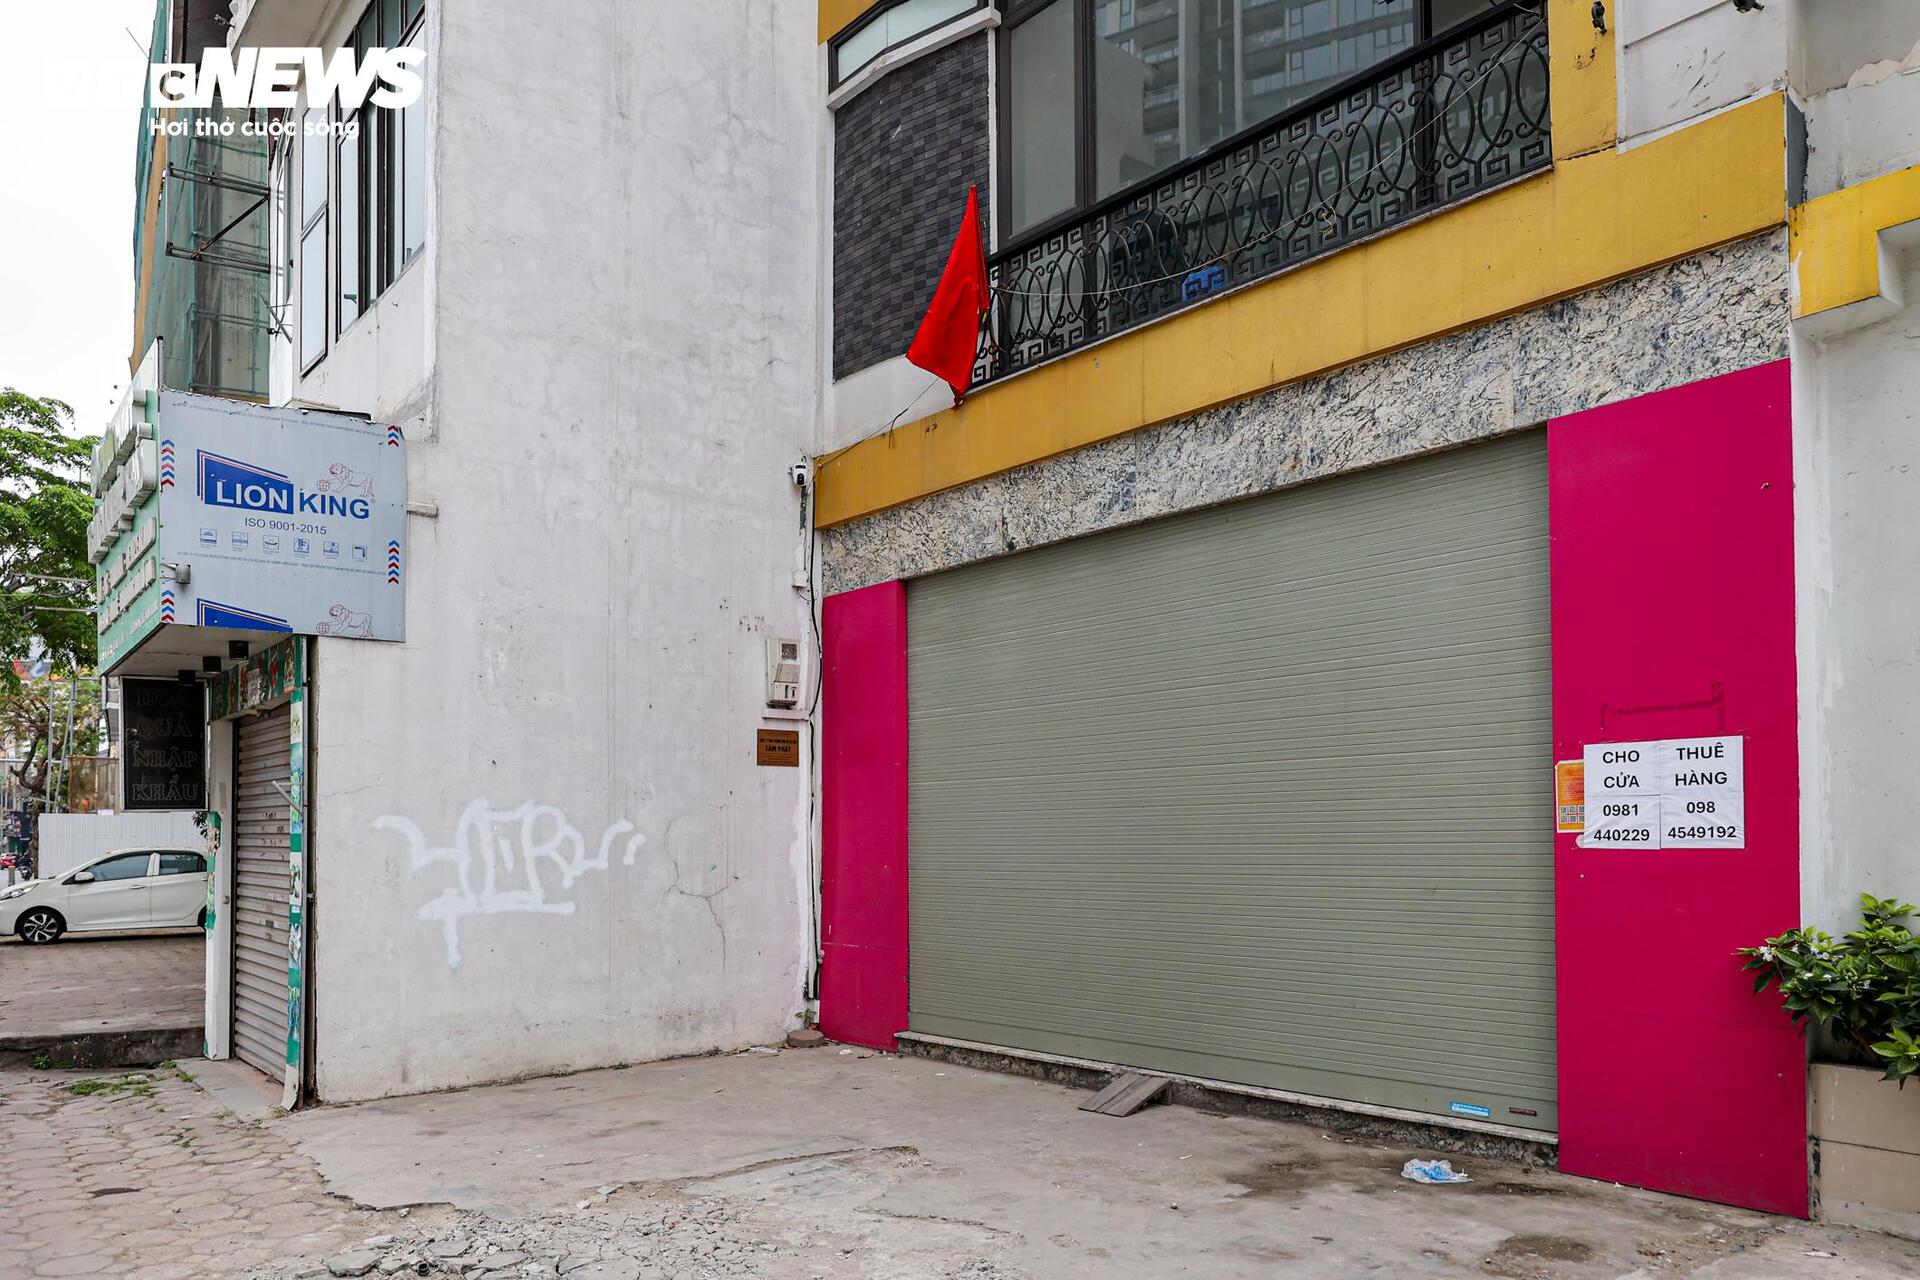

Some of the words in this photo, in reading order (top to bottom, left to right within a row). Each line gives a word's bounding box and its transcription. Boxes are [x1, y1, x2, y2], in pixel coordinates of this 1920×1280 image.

[216, 480, 288, 511] LION
[299, 492, 370, 520] KING
[244, 517, 266, 529] ISO
[269, 520, 327, 535] 9001-2015
[132, 744, 198, 772] NHẬP
[1602, 750, 1640, 764] CHO
[1676, 742, 1724, 760] THUÊ
[131, 774, 199, 801] KHẨU
[1603, 771, 1640, 788] CỬA
[1675, 769, 1728, 786] HÀNG
[1602, 803, 1639, 817] 0981
[1686, 801, 1716, 814] 098
[1593, 828, 1650, 842] 440229
[1667, 825, 1737, 839] 4549192
